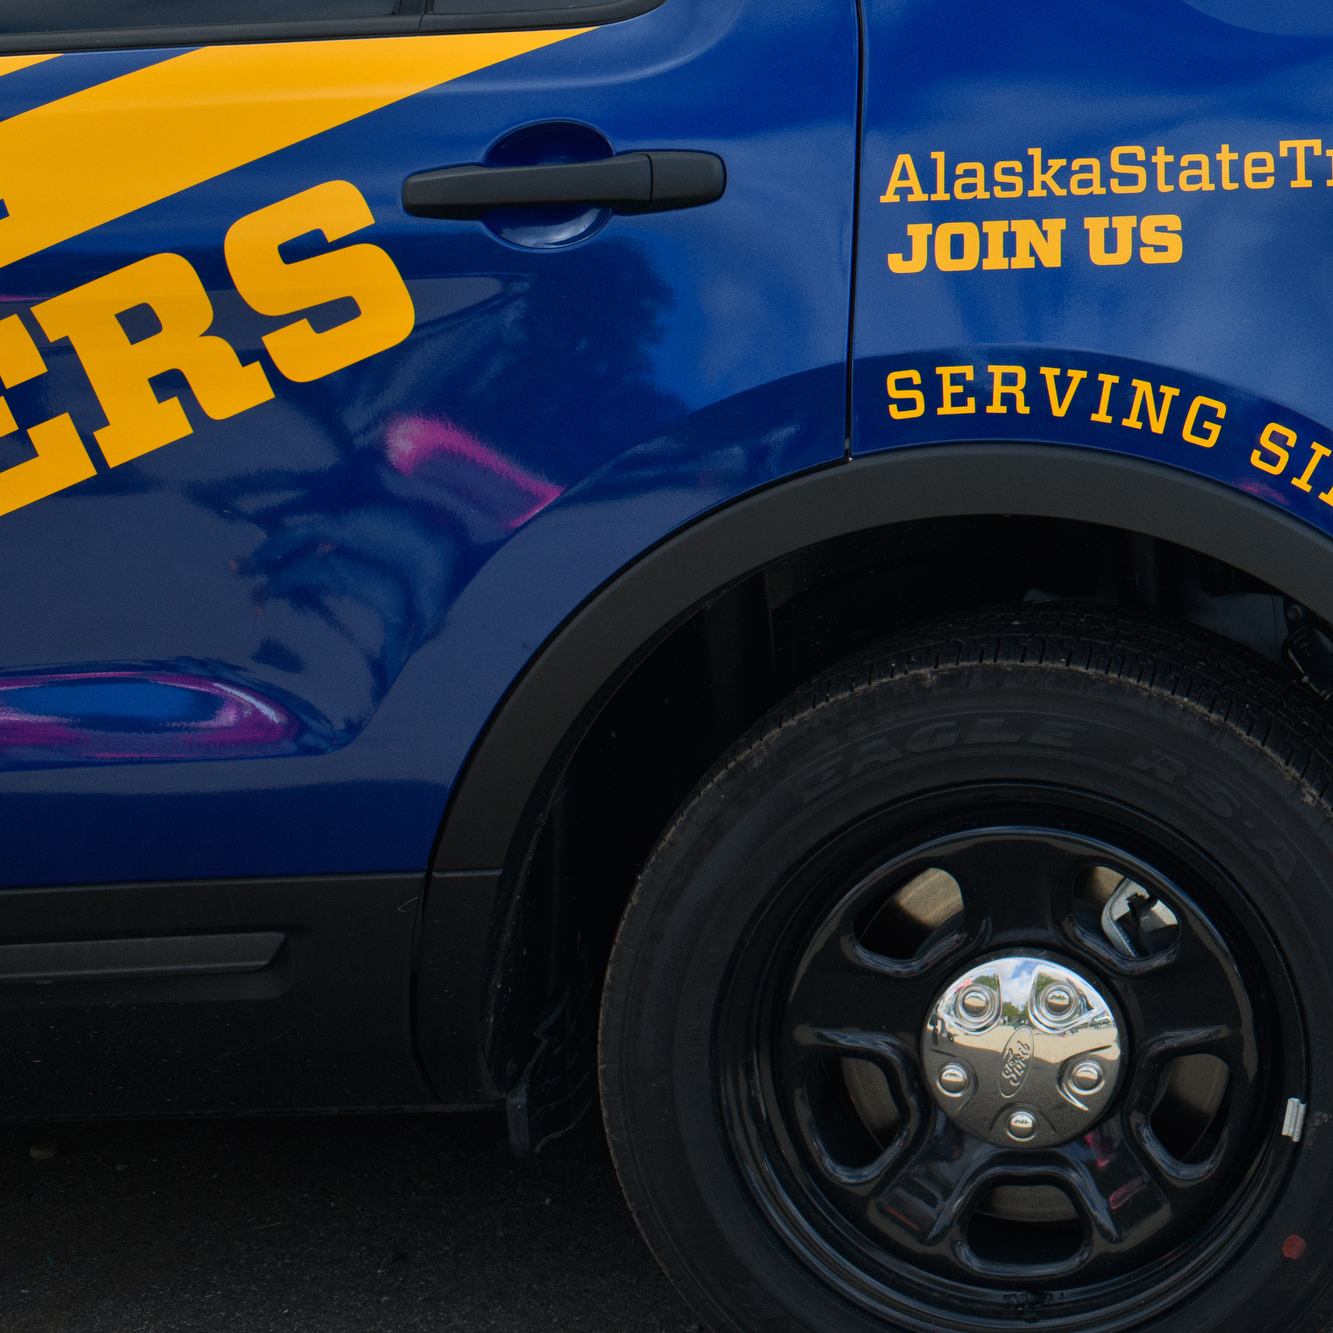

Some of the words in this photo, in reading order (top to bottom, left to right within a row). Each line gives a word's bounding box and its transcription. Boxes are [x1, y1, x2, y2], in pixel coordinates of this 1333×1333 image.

[887, 218, 1067, 274] JOIN
[1084, 214, 1183, 266] US
[886, 364, 1227, 448] SERVING
[802, 717, 1089, 805] EAGLE
